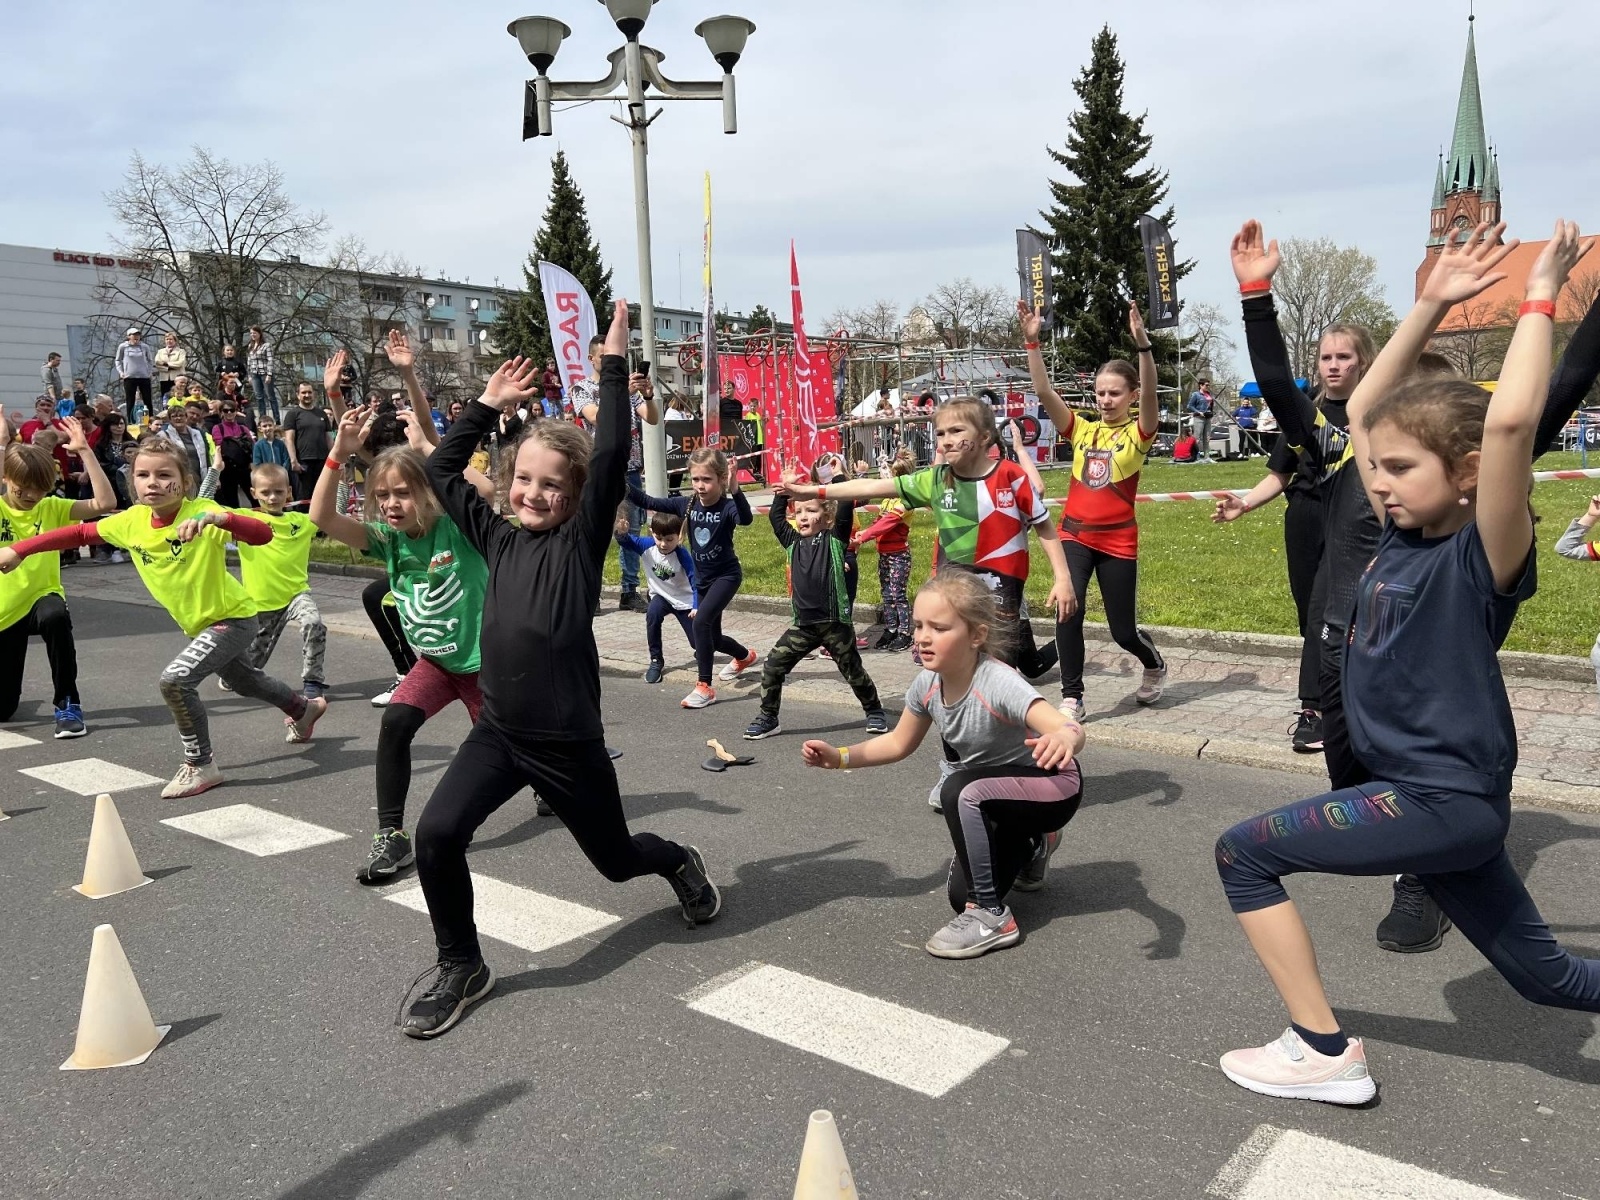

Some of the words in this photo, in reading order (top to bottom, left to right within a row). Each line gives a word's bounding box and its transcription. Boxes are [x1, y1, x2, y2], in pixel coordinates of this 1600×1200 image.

[53, 251, 90, 264] BLACK
[93, 256, 115, 267] RED
[682, 435, 737, 452] EXRT
[690, 510, 721, 523] MORE
[166, 632, 218, 677] SLEEP
